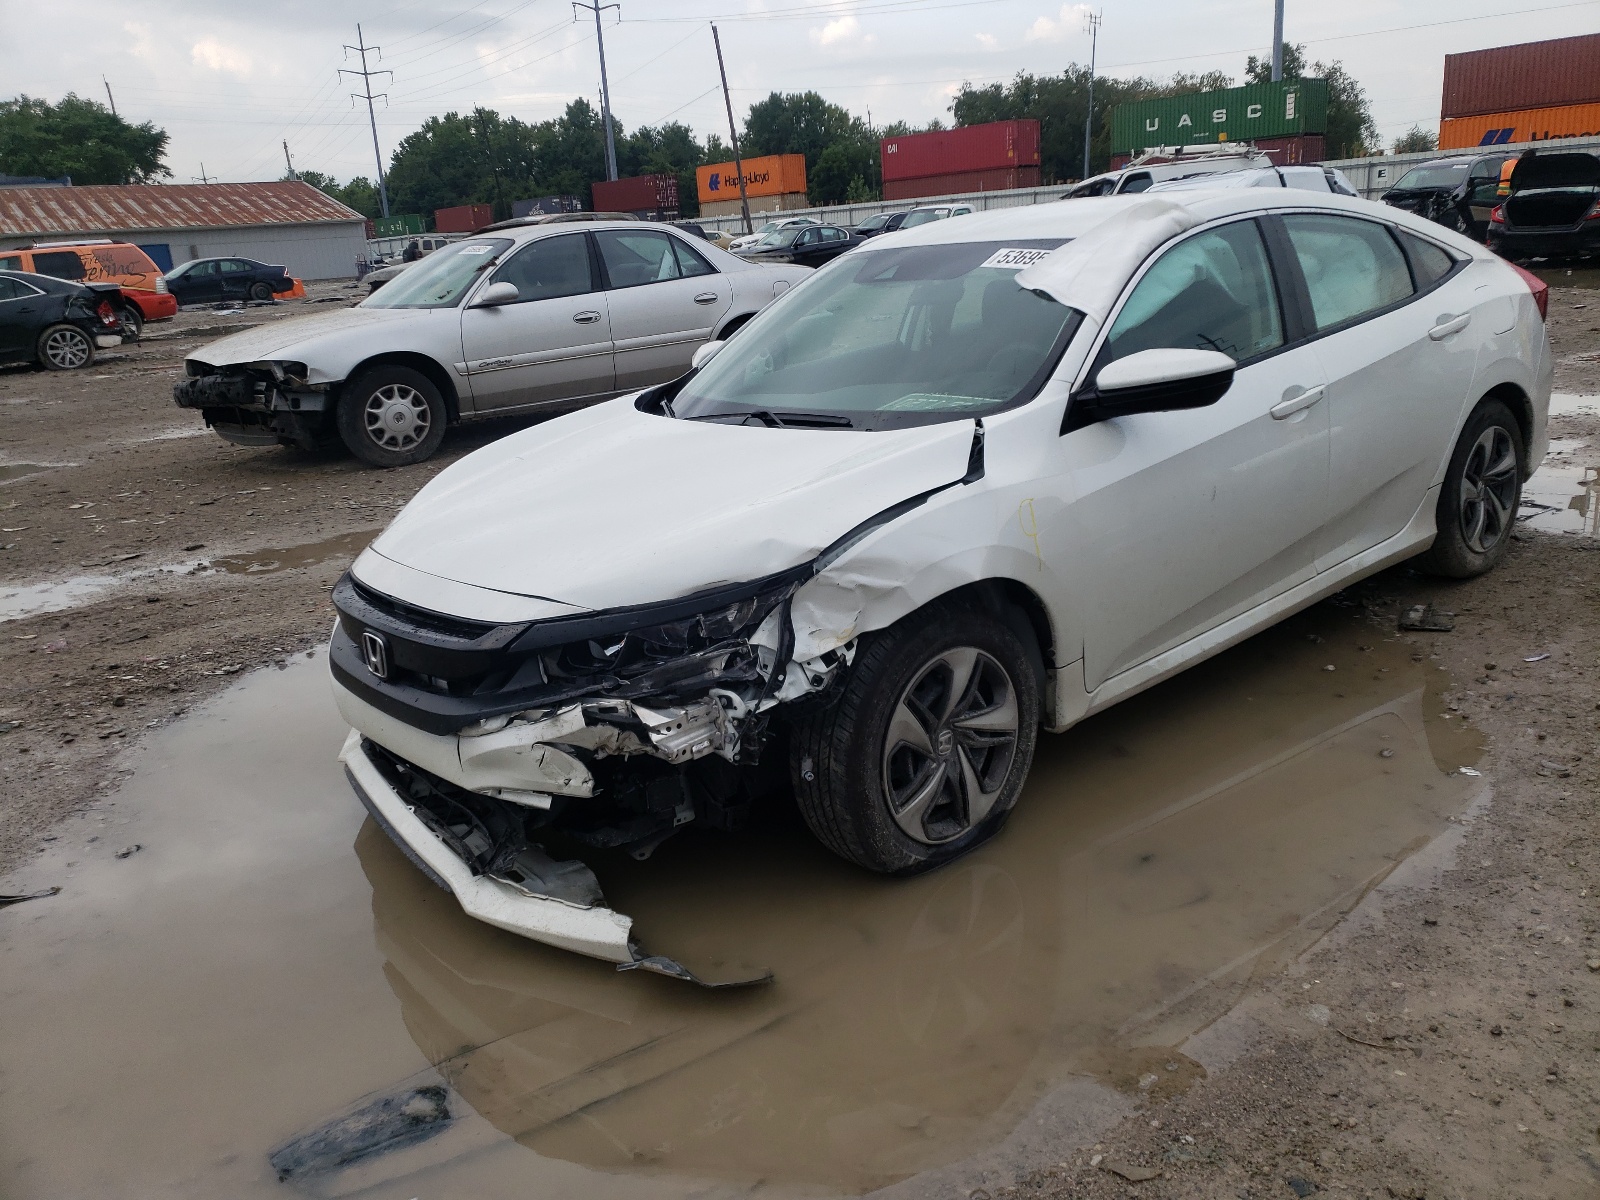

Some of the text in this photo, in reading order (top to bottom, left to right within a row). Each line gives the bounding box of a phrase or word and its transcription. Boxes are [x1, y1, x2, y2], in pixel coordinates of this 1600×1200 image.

[1146, 104, 1262, 132] UASC
[887, 143, 898, 154] CAI
[724, 170, 770, 188] Hapg-Lloyd
[1377, 169, 1387, 178] E
